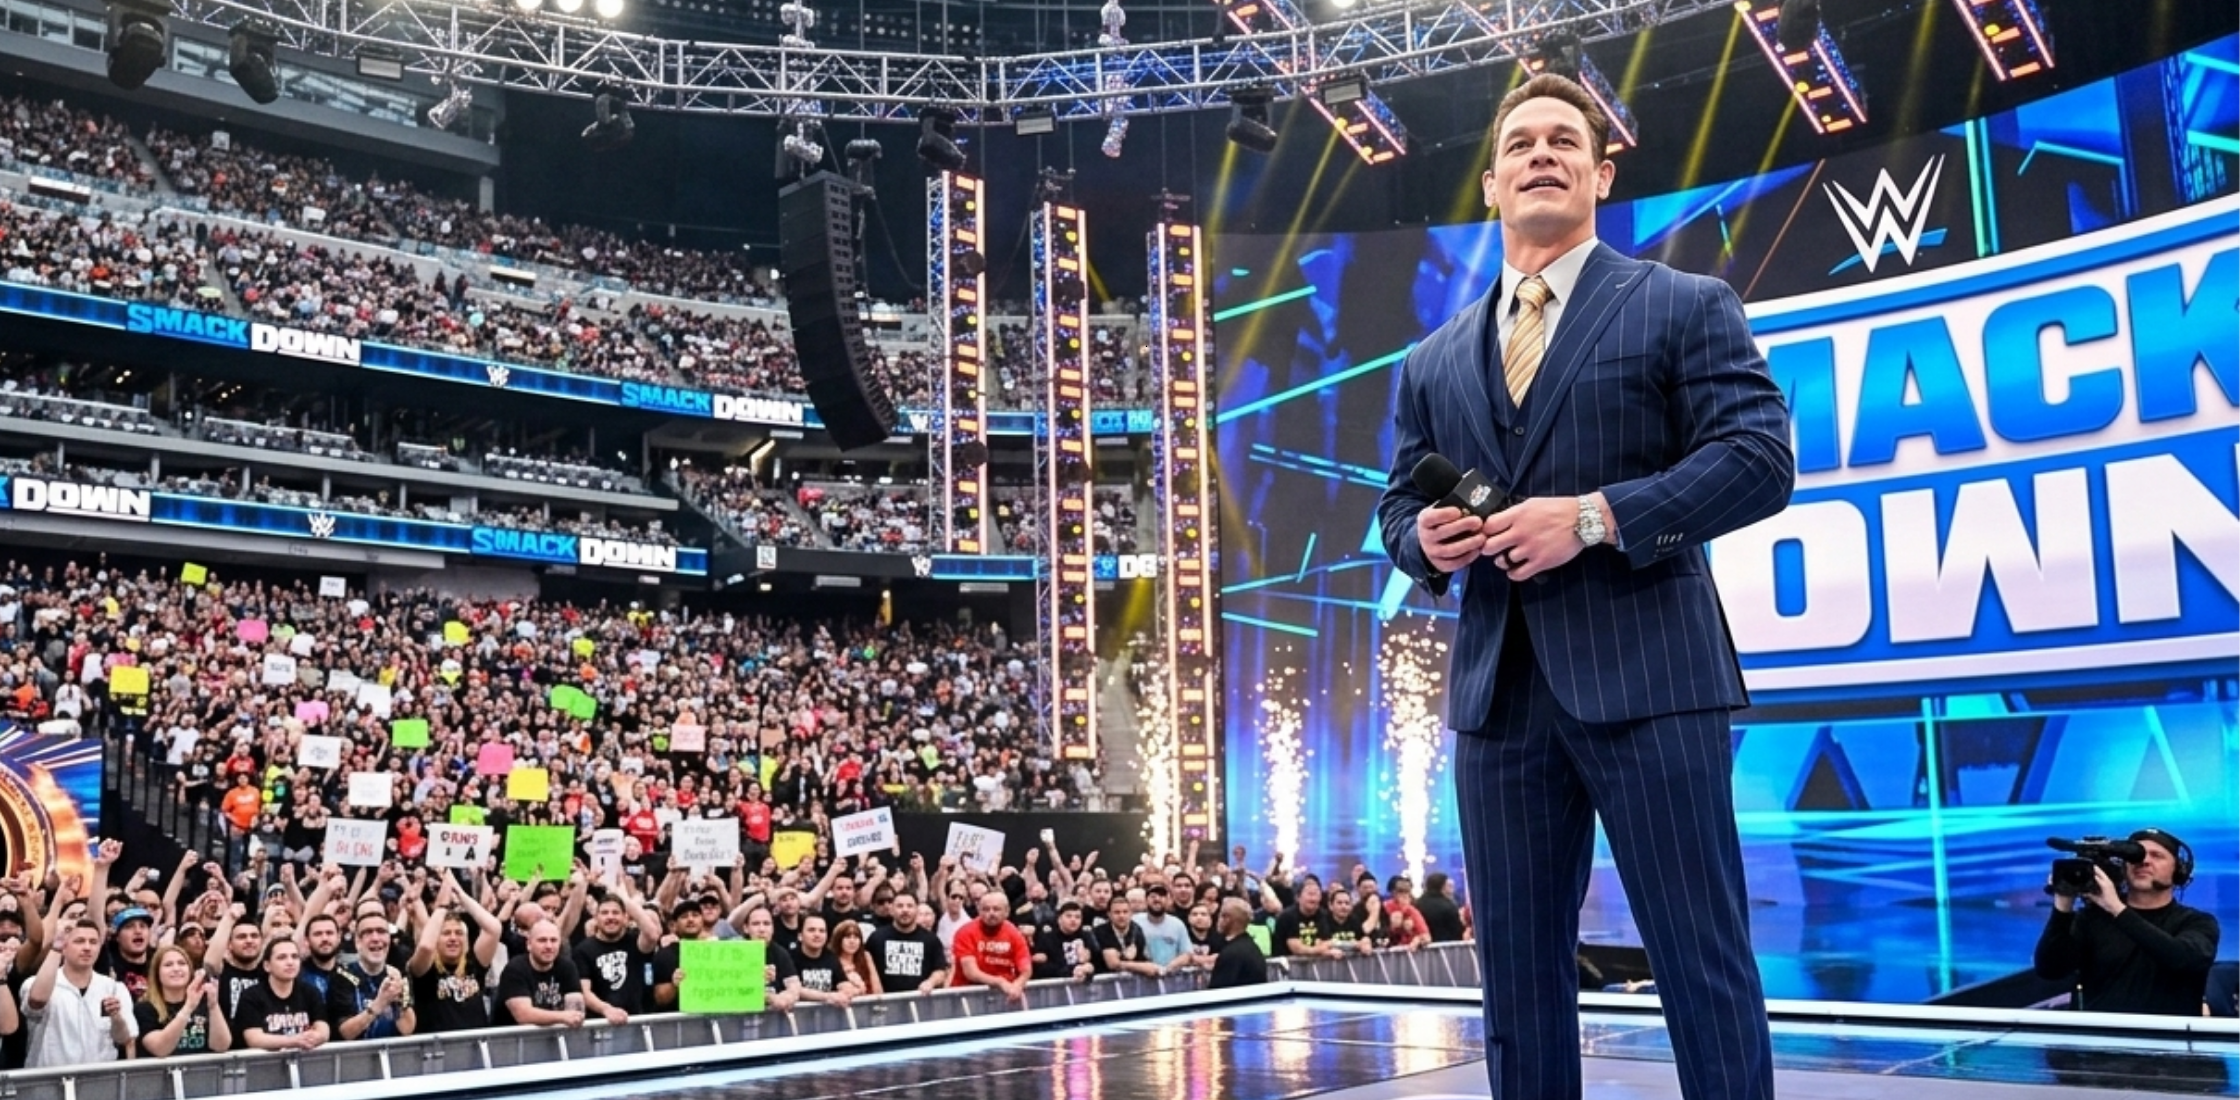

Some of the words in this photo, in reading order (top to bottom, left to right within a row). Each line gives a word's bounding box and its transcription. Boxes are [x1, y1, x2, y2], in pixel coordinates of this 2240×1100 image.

[127, 304, 249, 344] SMACK
[251, 323, 361, 363] DOWN
[1769, 246, 2240, 474] ACK
[621, 382, 712, 412] SMACK
[713, 394, 803, 423] DOWN
[13, 477, 151, 518] DOWN
[471, 526, 578, 558] SMACK
[1709, 443, 2240, 653] OWN
